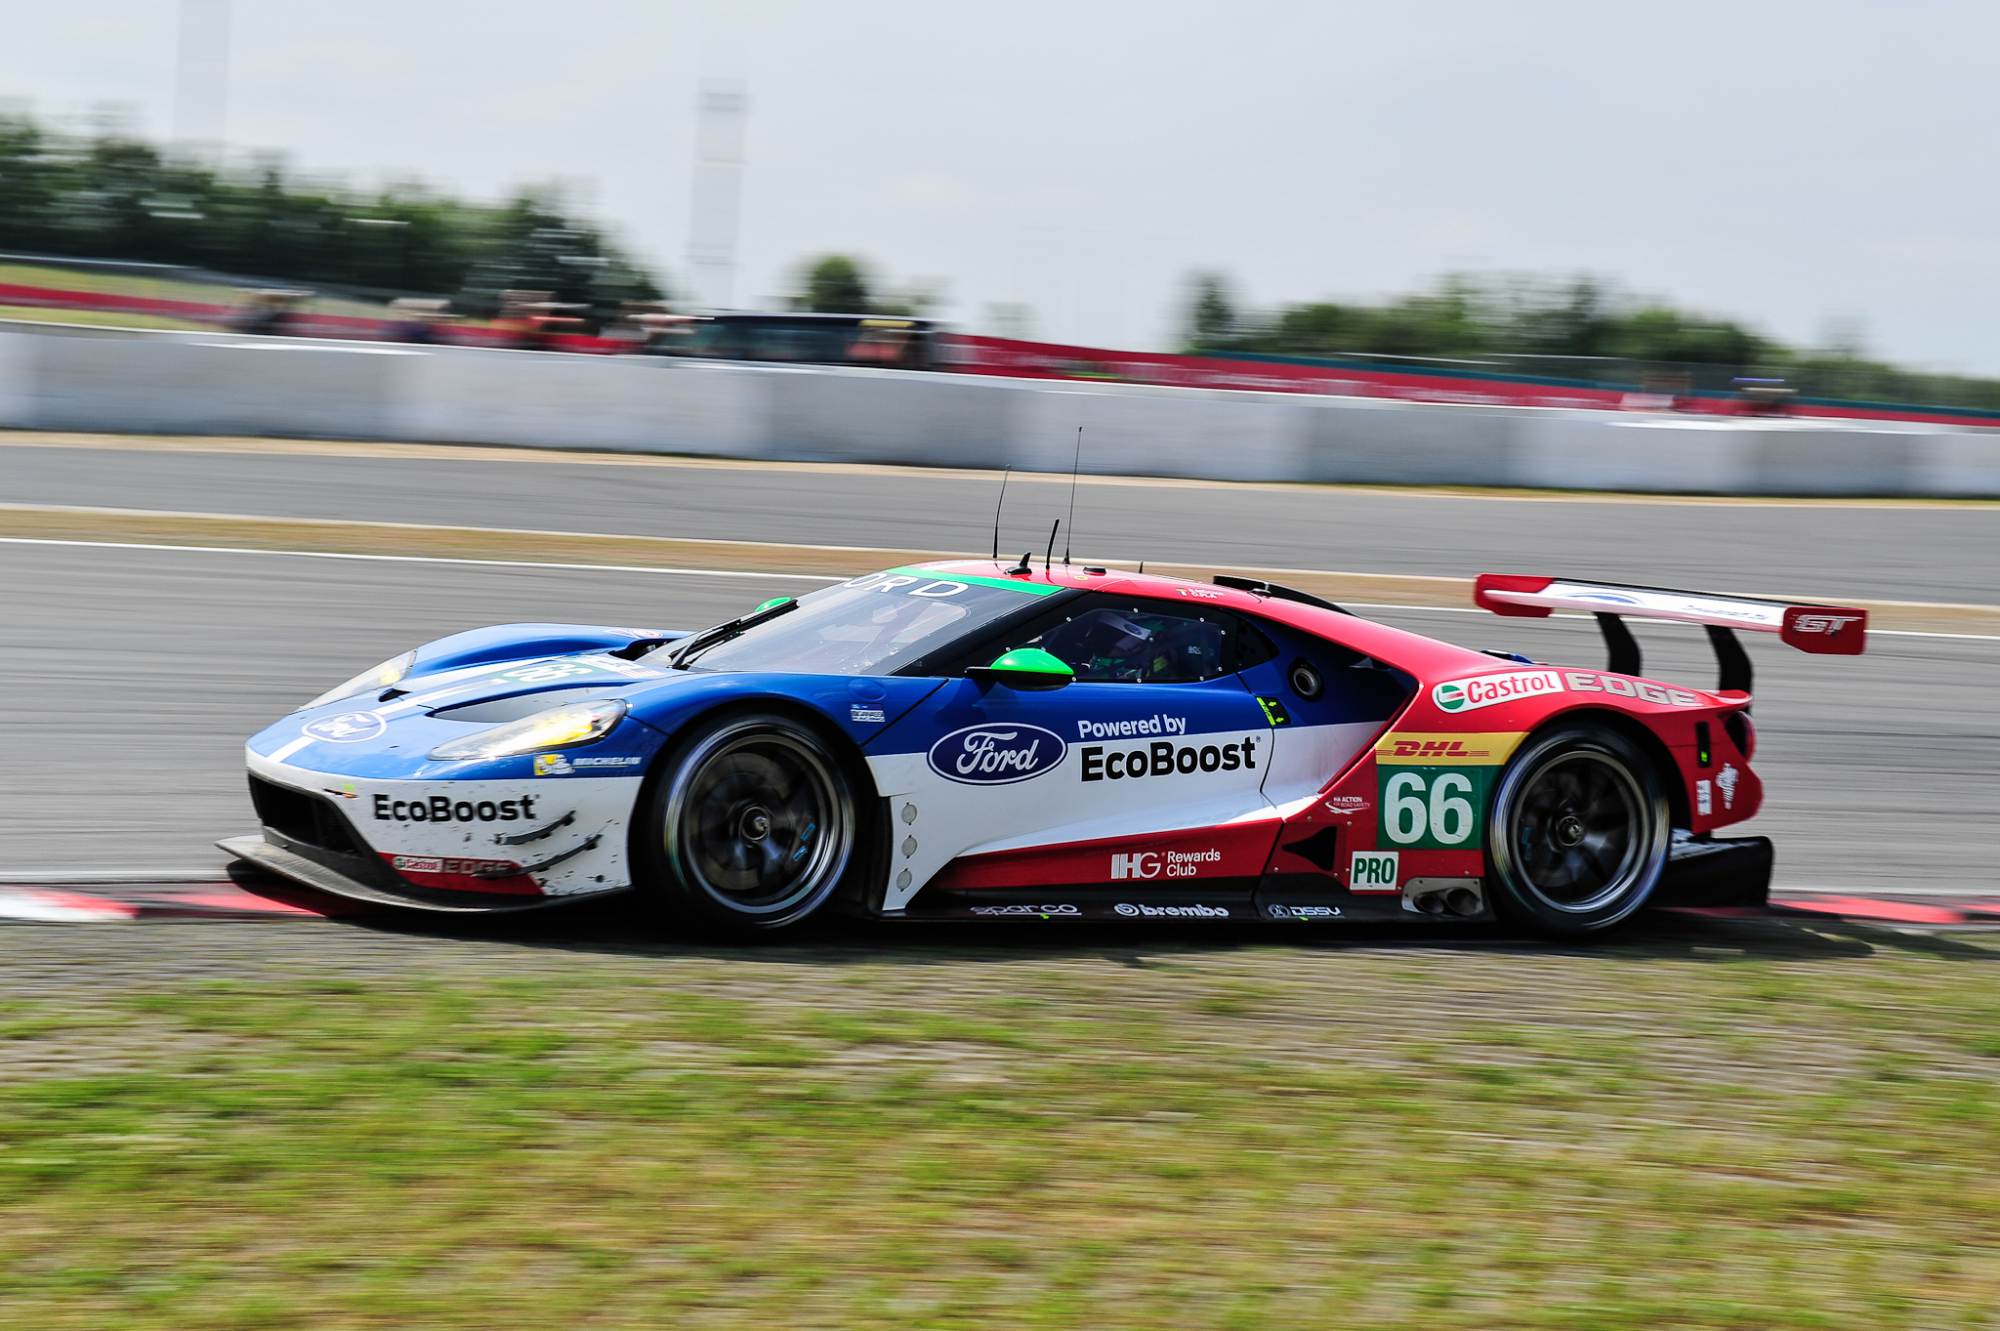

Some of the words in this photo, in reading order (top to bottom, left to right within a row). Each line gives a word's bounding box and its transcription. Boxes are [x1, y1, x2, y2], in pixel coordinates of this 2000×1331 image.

[1467, 673, 1555, 704] Castrol
[1564, 672, 1704, 707] EDGE
[1078, 714, 1162, 739] Powered
[1163, 713, 1187, 736] by
[956, 731, 1040, 774] Ford
[1081, 736, 1256, 782] EcoBoost
[1393, 740, 1470, 757] DHL
[373, 794, 536, 823] EcoBoost
[1384, 771, 1474, 845] 66
[1111, 851, 1162, 879] IHG
[1166, 863, 1197, 877] Club
[1167, 848, 1221, 864] Rewards
[1352, 857, 1396, 885] PRO
[1138, 903, 1230, 917] brembo
